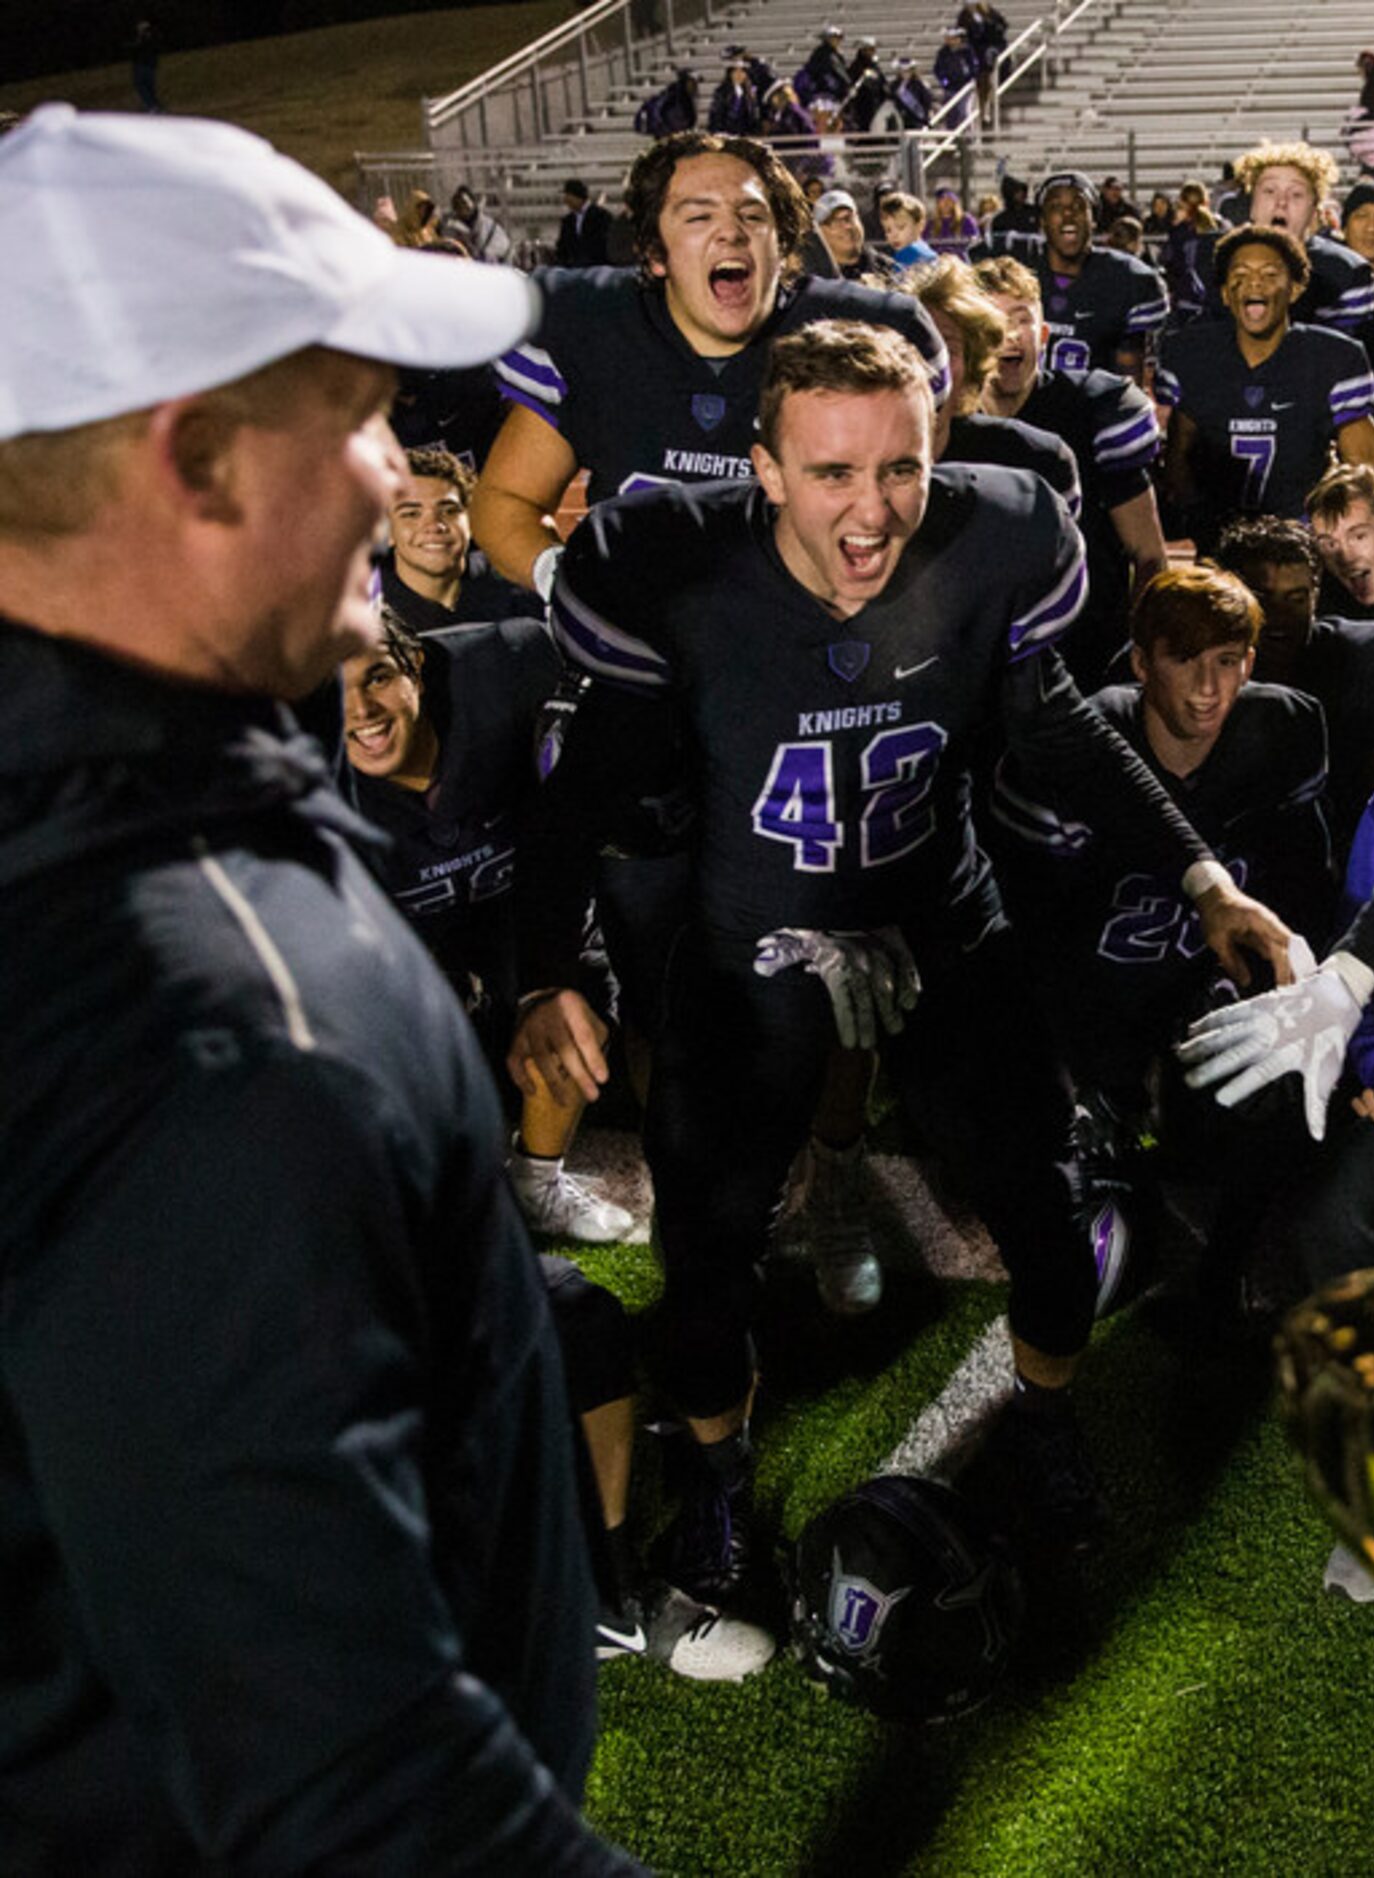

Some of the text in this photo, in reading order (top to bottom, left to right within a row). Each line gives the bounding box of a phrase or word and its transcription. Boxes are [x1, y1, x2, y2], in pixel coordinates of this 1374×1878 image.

[664, 449, 752, 479] KNIGHTS
[1231, 435, 1277, 505] 7
[799, 701, 902, 736] KNIGHTS
[753, 722, 948, 872] 42
